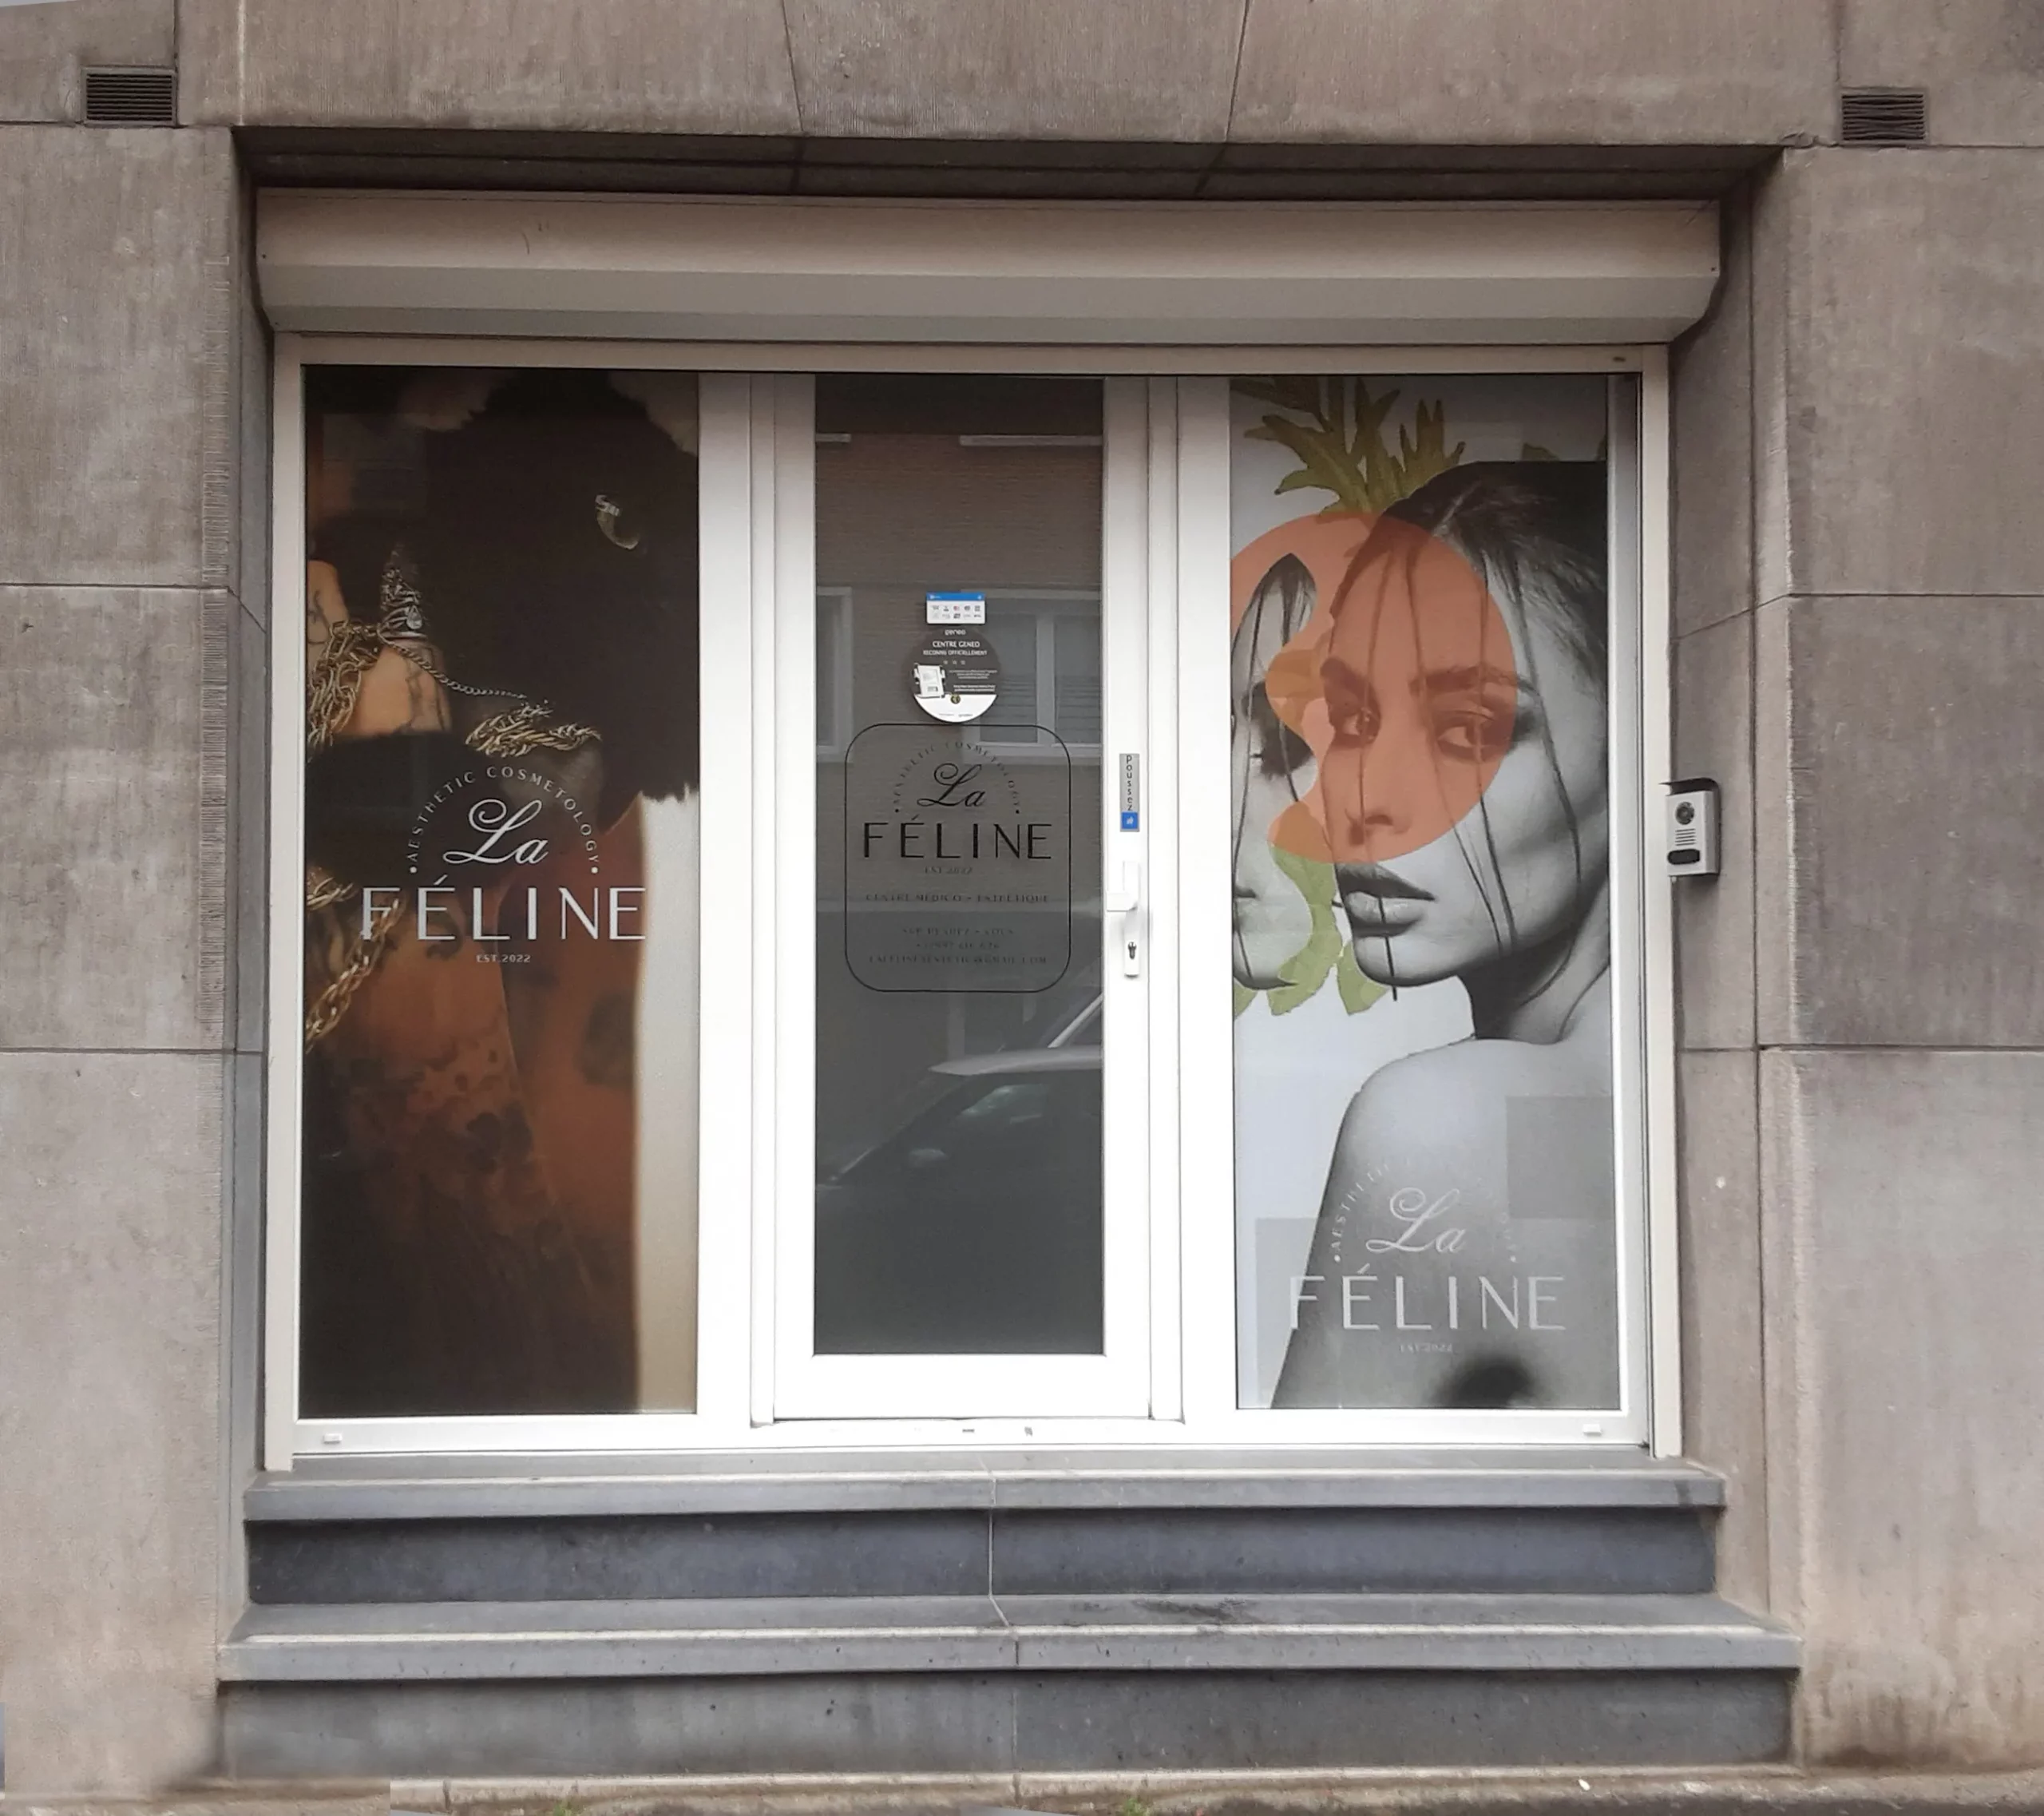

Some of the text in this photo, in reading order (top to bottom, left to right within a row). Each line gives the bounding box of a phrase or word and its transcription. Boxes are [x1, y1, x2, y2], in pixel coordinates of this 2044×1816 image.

[406, 765, 600, 864] AESTHETIC COSMETOLOGY
[917, 762, 986, 807] La
[442, 799, 549, 865] La
[863, 814, 1052, 859] FÉLINE
[362, 874, 647, 941] FÉLINE
[1365, 1188, 1468, 1253] La
[1290, 1263, 1567, 1330] FÉLINE
